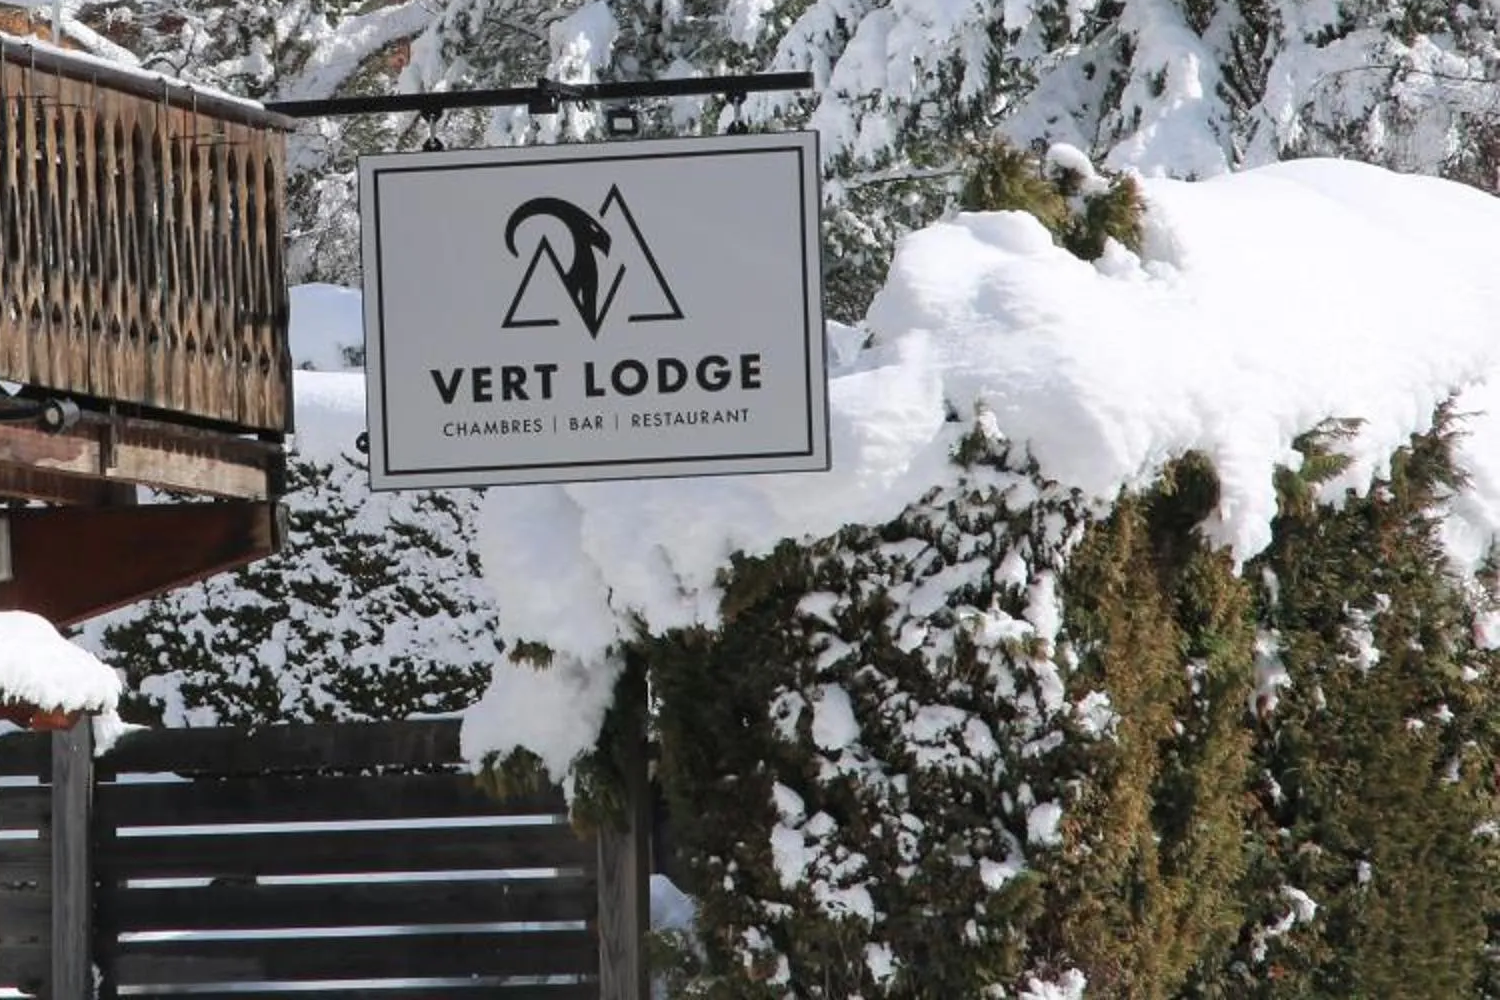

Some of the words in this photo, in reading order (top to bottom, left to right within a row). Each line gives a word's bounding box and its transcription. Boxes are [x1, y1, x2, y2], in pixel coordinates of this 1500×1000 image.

[429, 363, 559, 405] VERT
[583, 353, 763, 399] LODGE
[442, 418, 543, 438] CHAMBRES
[569, 415, 604, 432] BAR
[631, 408, 749, 428] RESTAURANT
